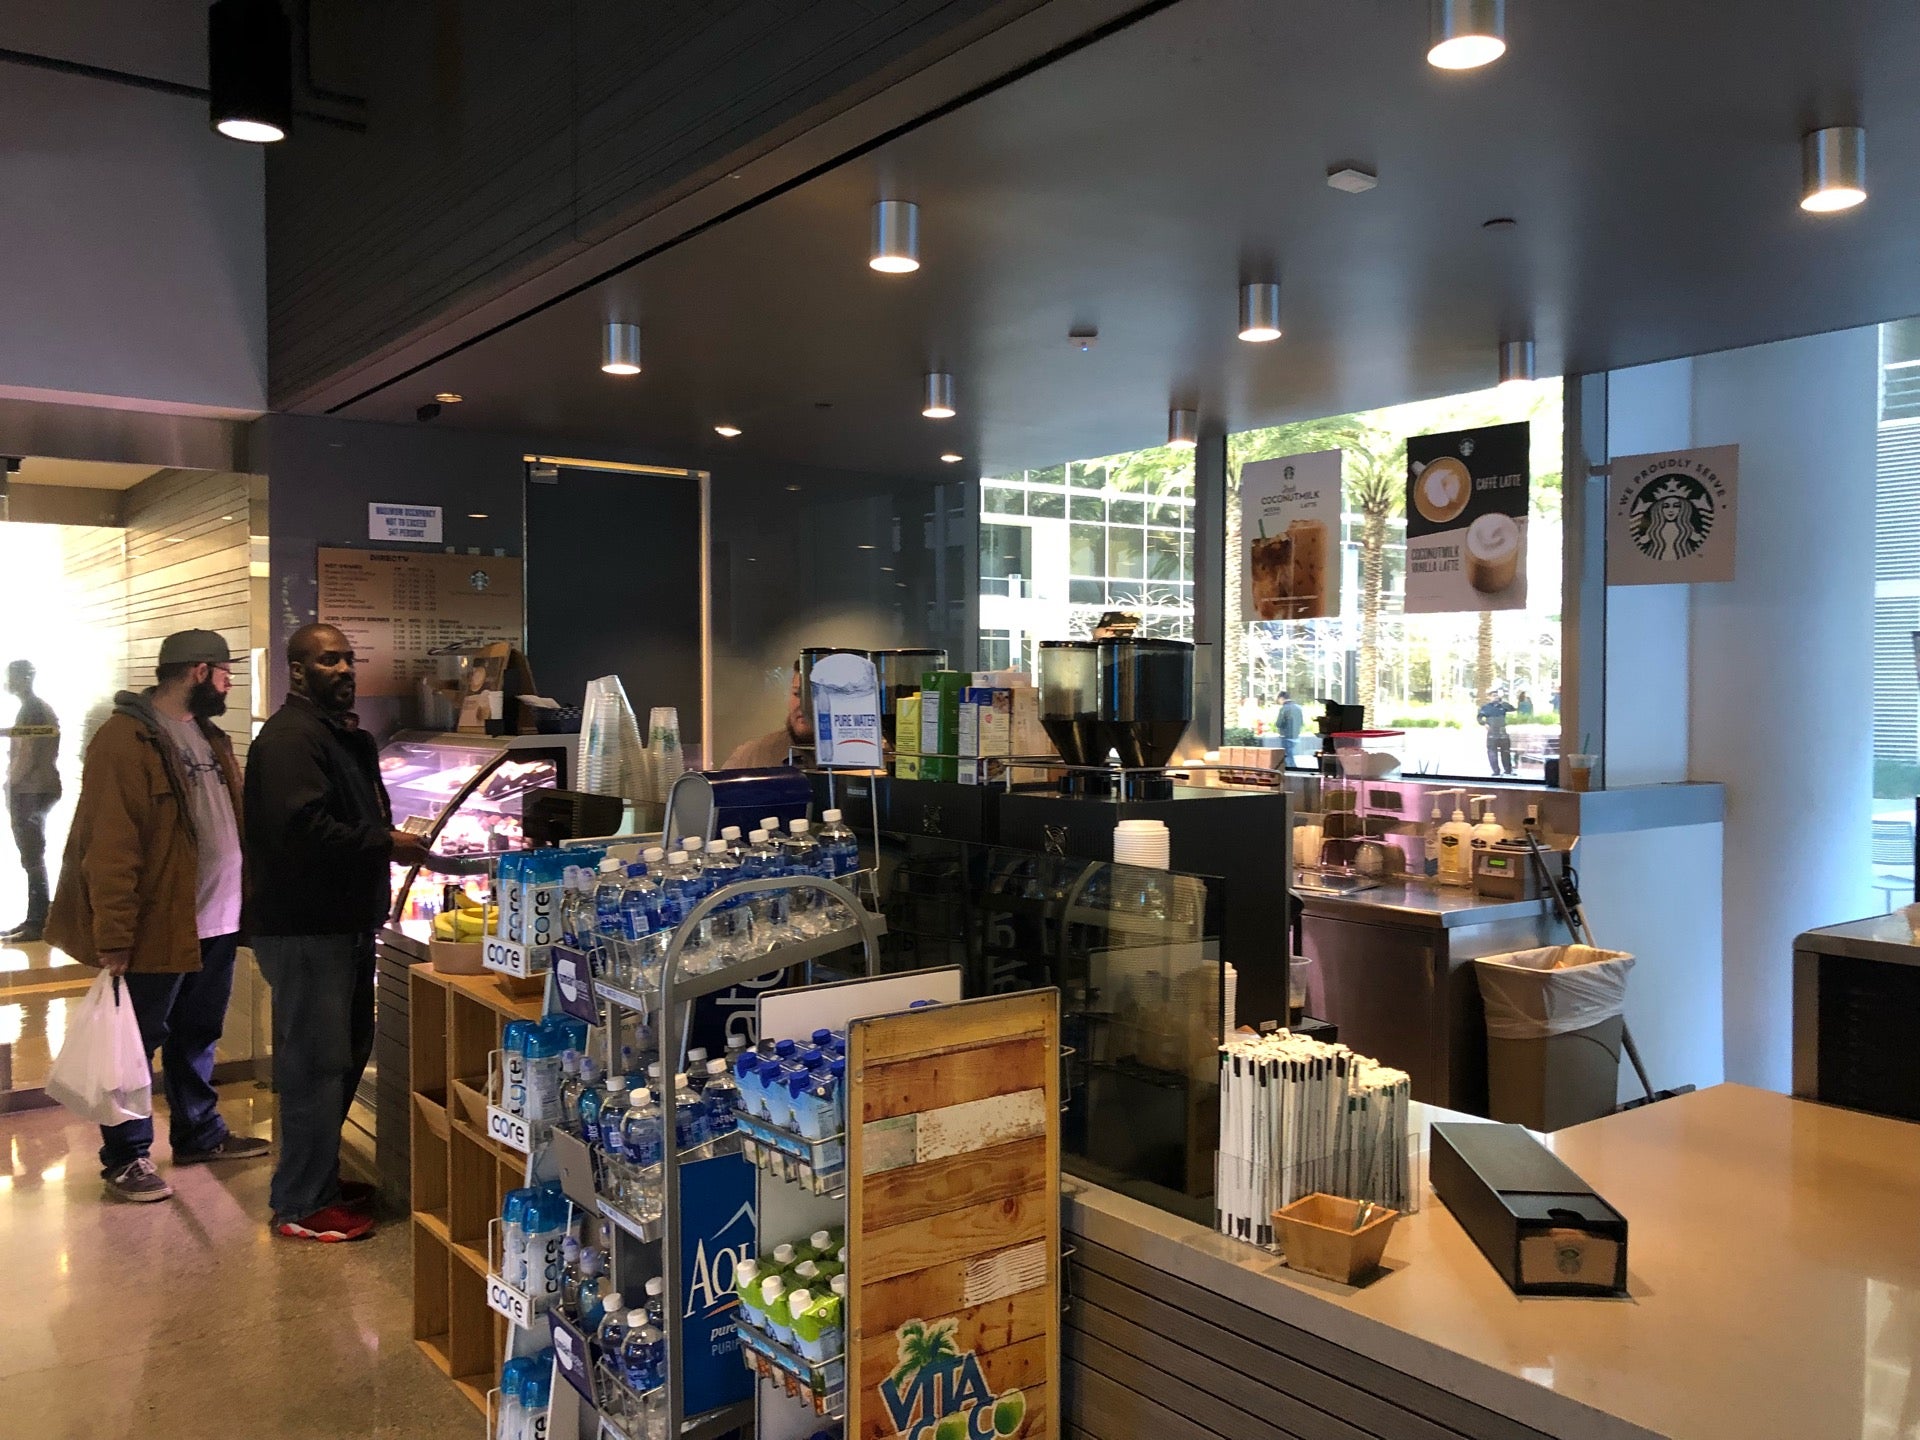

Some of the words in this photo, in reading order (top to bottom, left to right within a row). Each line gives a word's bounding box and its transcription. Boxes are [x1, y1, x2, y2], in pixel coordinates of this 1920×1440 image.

[1499, 473, 1522, 489] LATTE
[1619, 487, 1633, 505] WE
[1634, 458, 1692, 484] PROUDLY
[1695, 463, 1726, 497] SERVE
[1261, 490, 1320, 505] COCONUTMILK
[370, 554, 410, 562] DIRECTV
[1411, 545, 1460, 561] COCONUTMILK
[1411, 561, 1437, 573] VANILLA
[1438, 559, 1460, 572] LATTE
[834, 714, 853, 727] PURE
[853, 714, 877, 727] WATER
[535, 890, 550, 945] core
[487, 943, 520, 969] core
[491, 1114, 524, 1144] core
[544, 1239, 558, 1293] core
[491, 1285, 523, 1318] core
[710, 1323, 737, 1342] pure
[711, 1340, 741, 1357] PURIF
[878, 1349, 991, 1432] VITA
